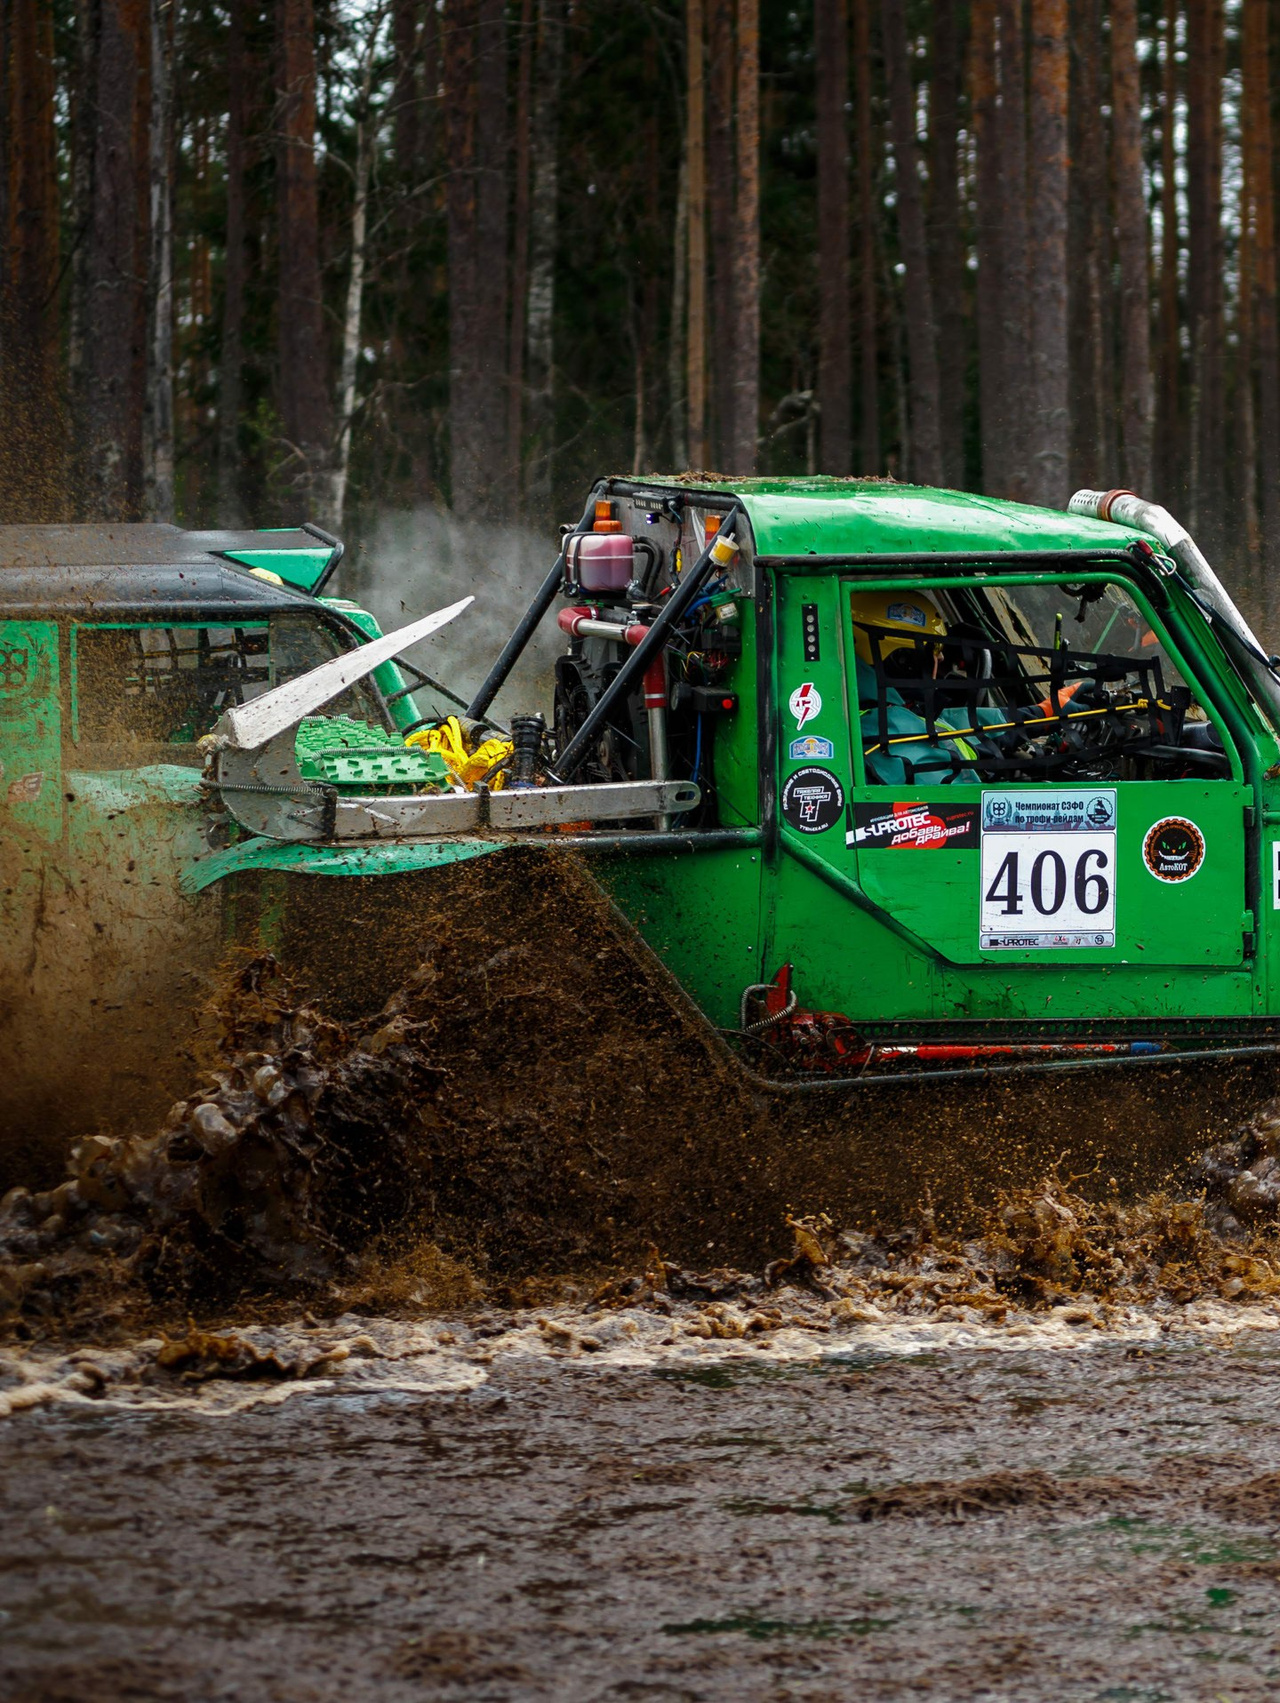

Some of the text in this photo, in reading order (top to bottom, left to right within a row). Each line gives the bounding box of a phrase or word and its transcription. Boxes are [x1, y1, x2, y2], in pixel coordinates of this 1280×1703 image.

[1015, 800, 1084, 811] Чемпионат СЗФО
[864, 811, 931, 837] SUPROTEC
[1015, 815, 1025, 824] по
[1026, 813, 1084, 824] трофи-рейдам
[891, 825, 941, 845] добавь
[915, 821, 971, 846] драйва!
[985, 849, 1109, 915] 406
[997, 938, 1039, 947] SUPROTEC
